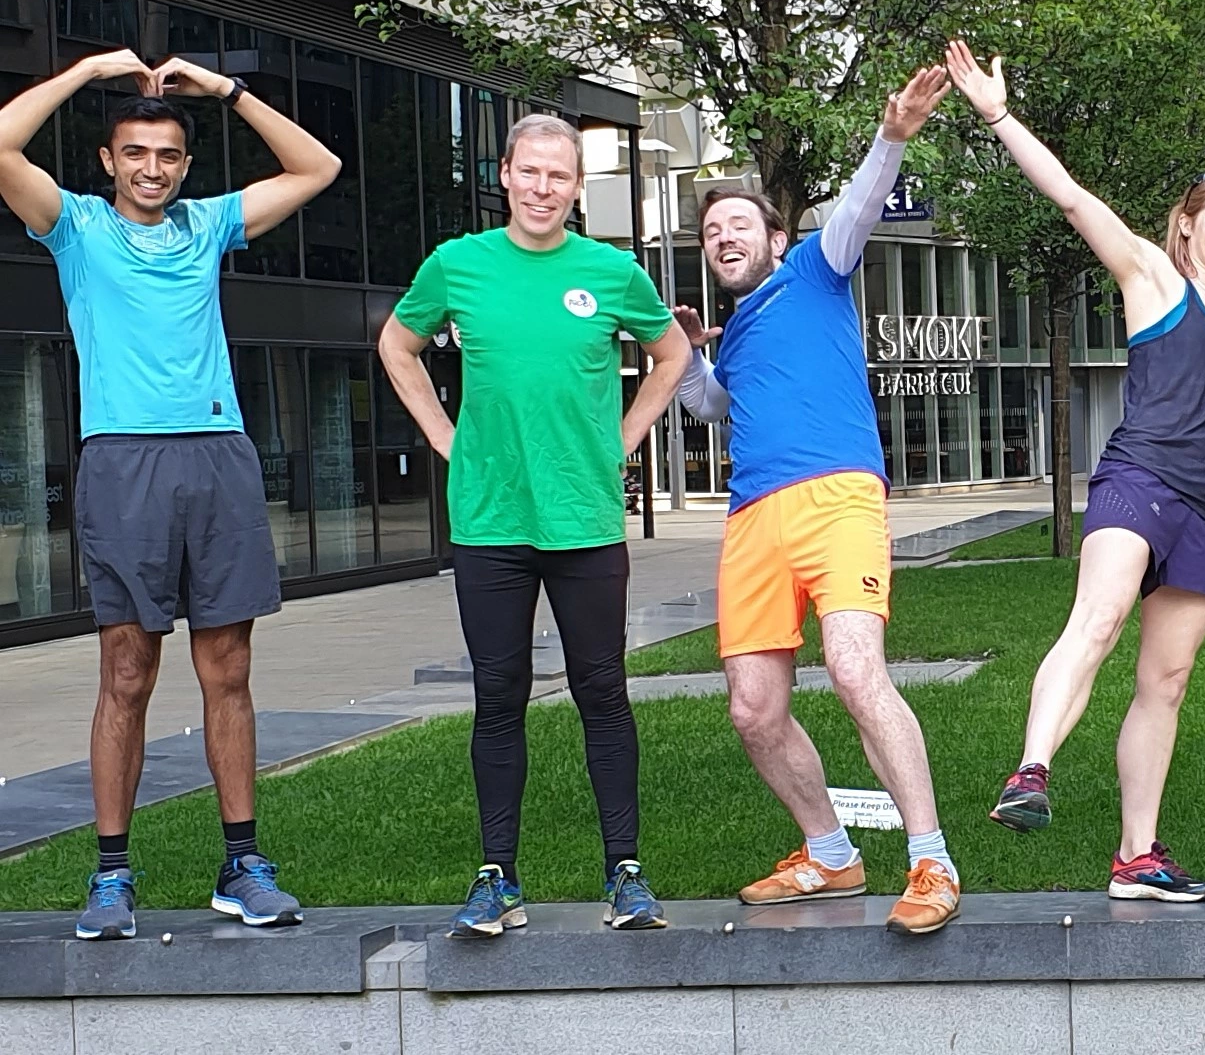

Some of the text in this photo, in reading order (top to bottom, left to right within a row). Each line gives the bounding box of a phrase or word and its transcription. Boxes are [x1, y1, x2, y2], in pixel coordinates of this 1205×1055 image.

[876, 314, 994, 361] SMOKE
[833, 799, 859, 810] Please
[861, 801, 881, 811] Keep
